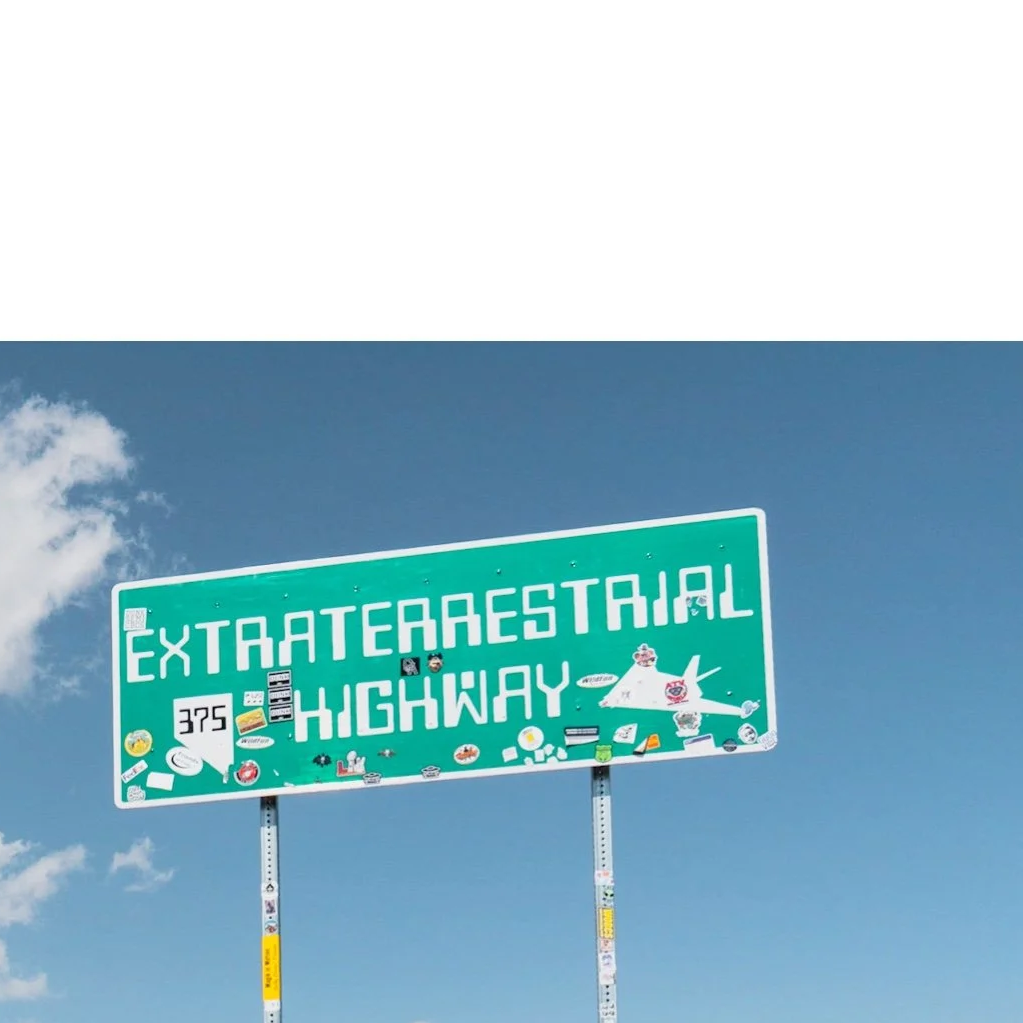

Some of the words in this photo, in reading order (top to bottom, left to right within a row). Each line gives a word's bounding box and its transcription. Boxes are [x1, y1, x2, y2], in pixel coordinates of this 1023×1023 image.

[126, 564, 753, 683] EXTRATERRESTRIAL
[179, 705, 227, 735] 375
[294, 661, 569, 743] HIGHWAY
